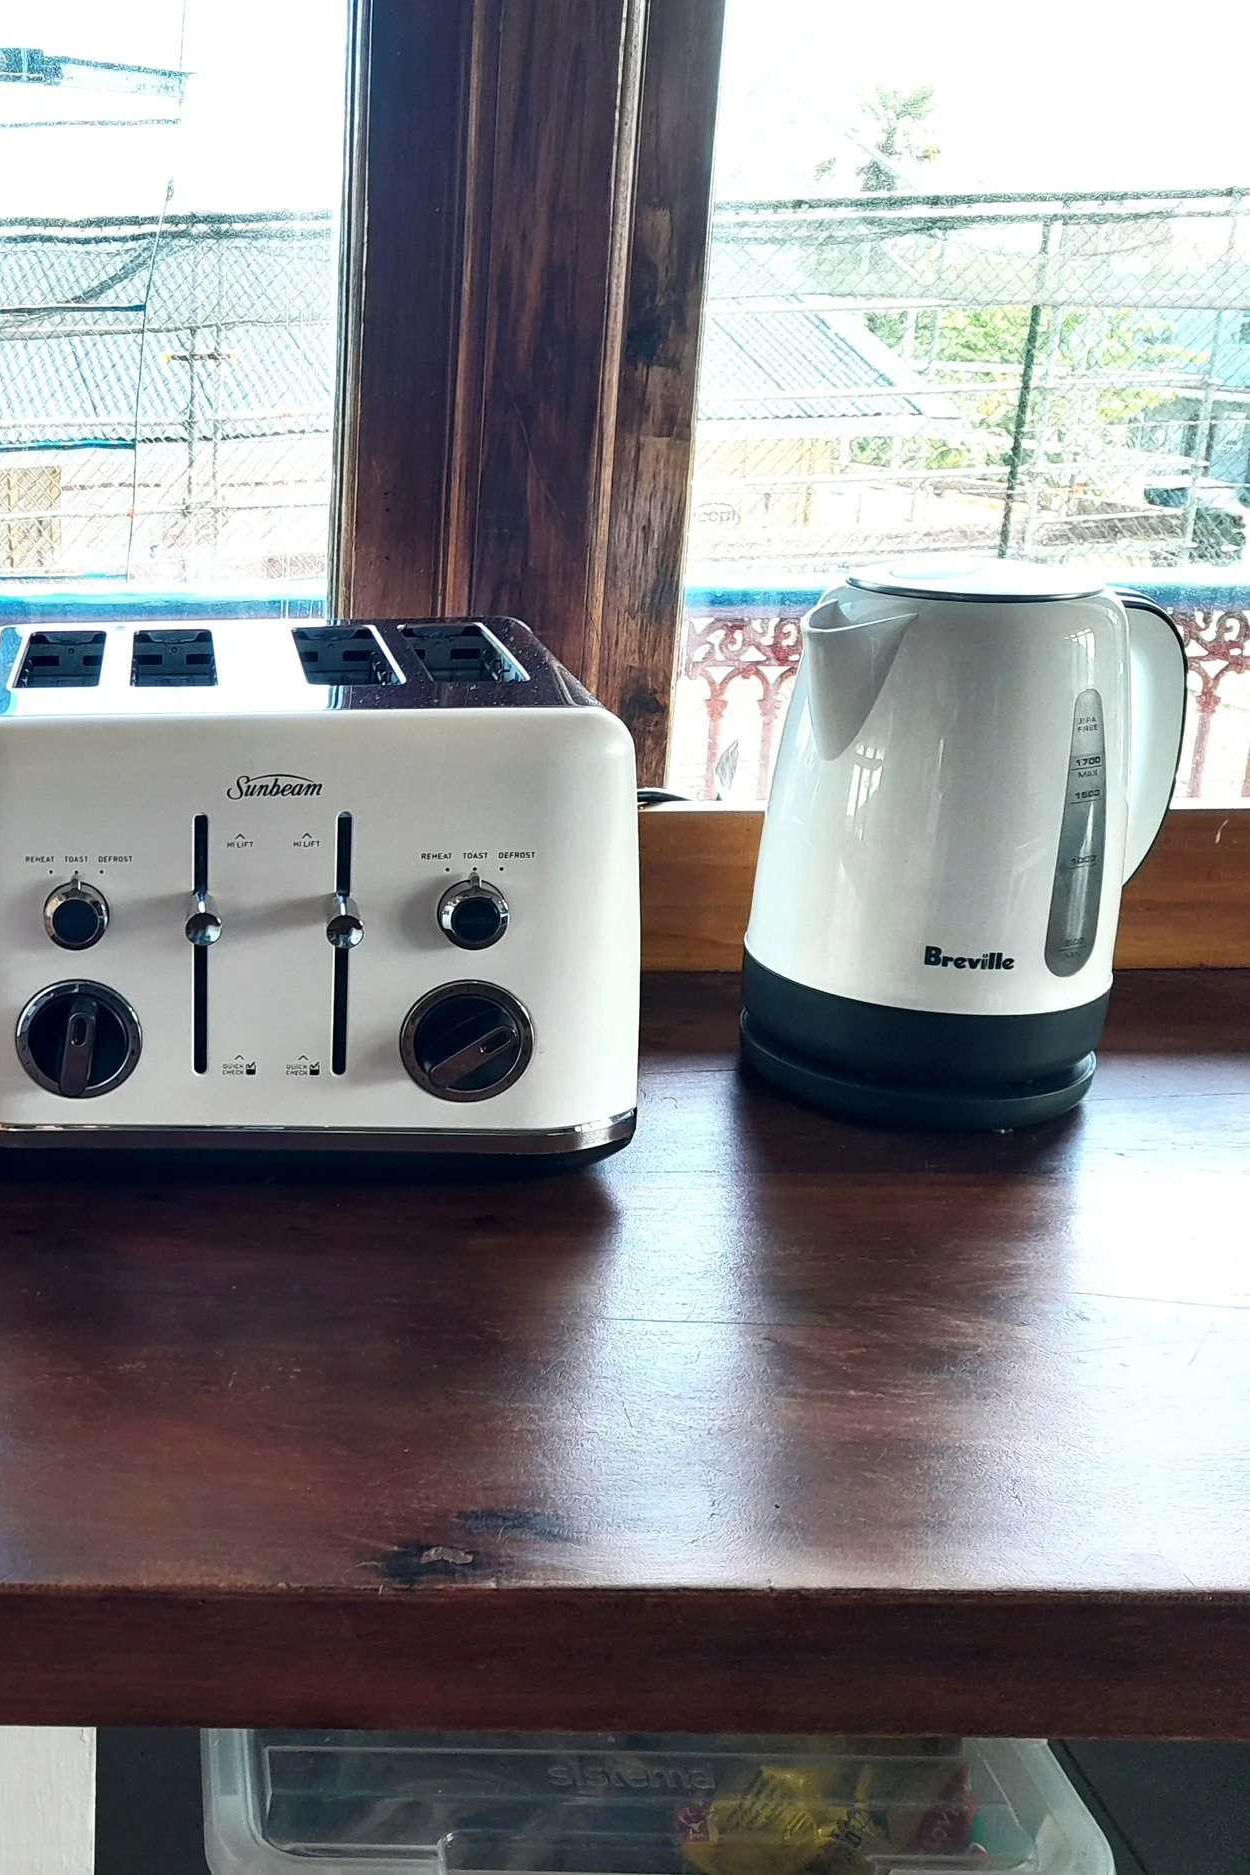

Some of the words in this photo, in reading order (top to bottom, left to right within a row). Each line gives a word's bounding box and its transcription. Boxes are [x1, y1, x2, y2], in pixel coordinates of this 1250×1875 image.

[1075, 756, 1101, 767] 1700
[226, 774, 323, 800] Sunbeam
[236, 841, 254, 849] LIFT
[303, 840, 320, 848] LIFT
[98, 855, 133, 863] DEFROST
[498, 851, 535, 859] DEFROST
[924, 945, 1015, 970] Breville
[548, 1760, 717, 1790] sistema
